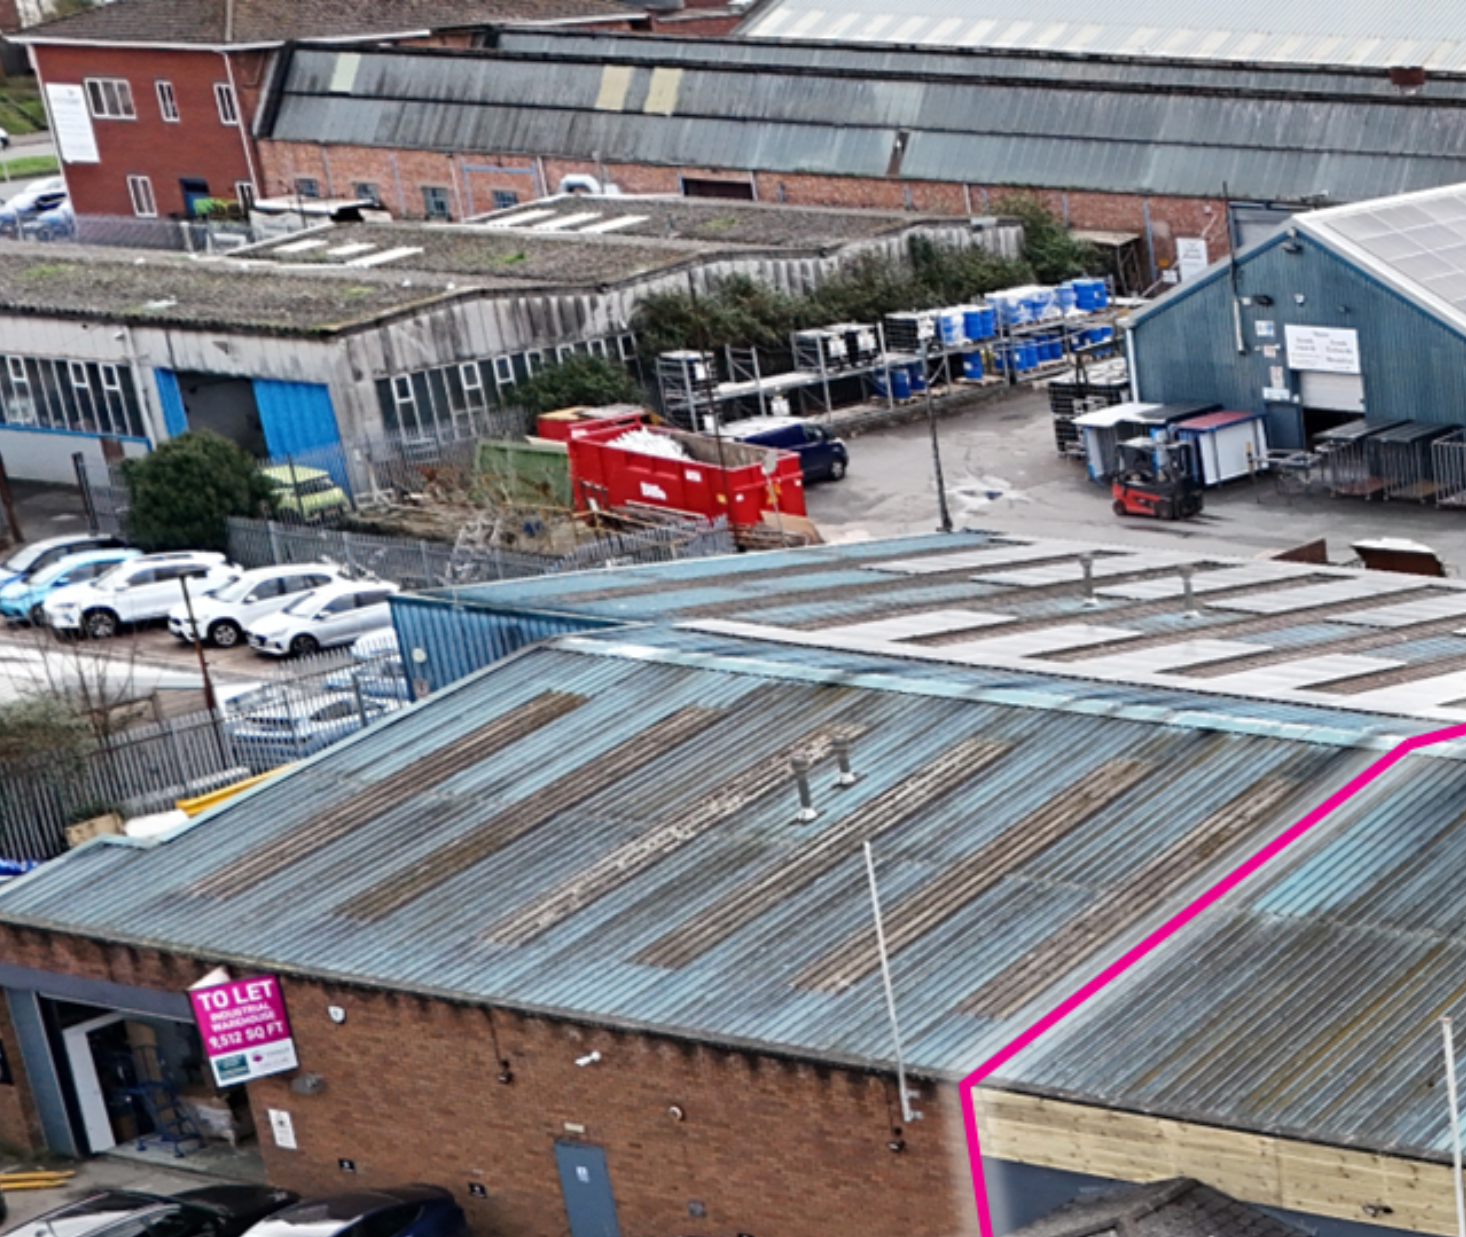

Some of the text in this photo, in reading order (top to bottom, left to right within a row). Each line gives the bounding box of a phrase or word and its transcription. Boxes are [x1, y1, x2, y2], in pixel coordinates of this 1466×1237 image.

[197, 979, 273, 1011] TO LET
[210, 1001, 270, 1021] INDUSTRIAL
[210, 1009, 275, 1032] WAREHOUSE
[245, 1025, 265, 1041] SQ
[266, 1020, 283, 1036] FT
